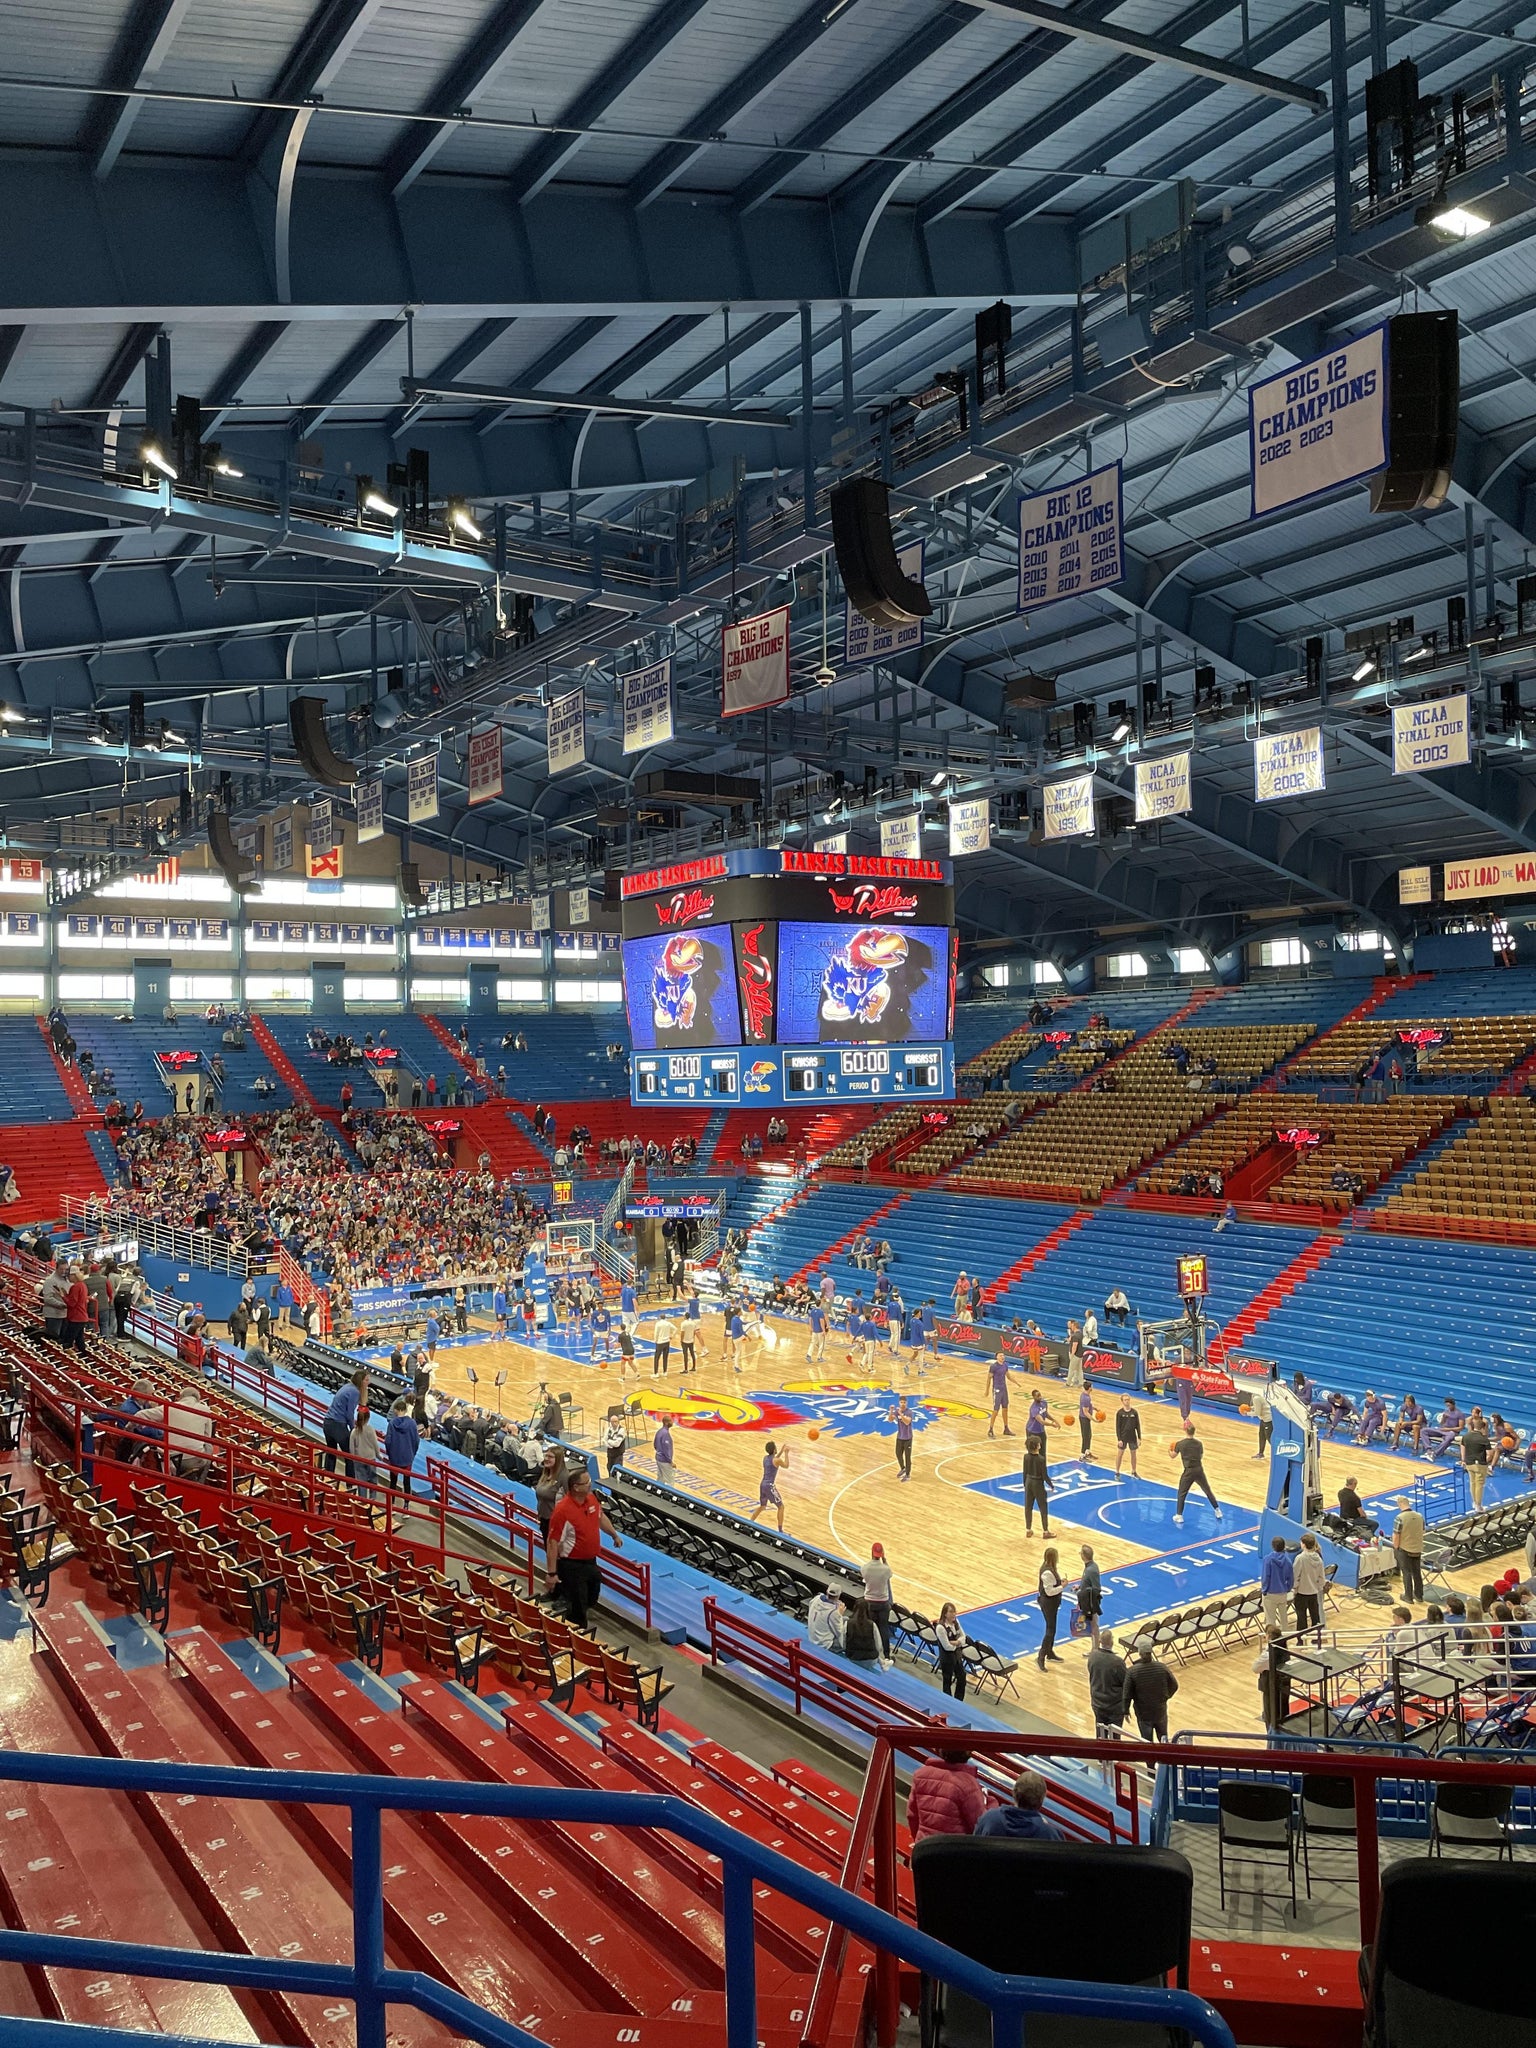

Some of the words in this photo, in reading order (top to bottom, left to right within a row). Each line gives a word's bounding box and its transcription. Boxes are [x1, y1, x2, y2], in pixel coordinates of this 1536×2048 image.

[1285, 370, 1320, 405] BIG
[1327, 354, 1347, 386] 12
[1259, 370, 1377, 443] CHAMPIONS
[1259, 440, 1293, 466] 2022
[1299, 420, 1334, 452] 2023
[1045, 492, 1073, 520] BIG
[1075, 485, 1093, 510] 12
[1024, 502, 1115, 550] CHAMPIONS
[1023, 550, 1049, 569] 2010
[1059, 540, 1081, 560] 2011
[1090, 527, 1116, 548] 2012
[1023, 566, 1048, 586] 2013
[1058, 556, 1081, 577] 2014
[1091, 544, 1117, 566] 2015
[1022, 583, 1047, 603] 2016
[1057, 574, 1082, 594] 2017
[1090, 560, 1119, 583] 2020
[739, 627, 757, 646] BIG
[759, 621, 771, 640] 12
[727, 635, 784, 668] CHAMPIONS
[628, 675, 641, 694] BIG
[642, 666, 666, 690] EIGHT
[626, 682, 668, 711] CHAMPIONS
[551, 705, 562, 721] BIG
[562, 695, 581, 716] EIGHT
[1412, 705, 1448, 726] NCAA
[549, 711, 583, 737] CHAMPIONS
[1397, 727, 1432, 745] FINAL
[1434, 720, 1464, 739] FOUR
[1272, 736, 1304, 755] NCAA
[470, 746, 500, 768] CHAMPIONS
[1260, 755, 1289, 774] FINAL
[1290, 749, 1319, 767] FOUR
[1412, 744, 1449, 765] 2003
[1149, 763, 1176, 780] NCAA
[1139, 779, 1164, 796] FINAL
[1165, 774, 1188, 790] FOUR
[1273, 772, 1306, 792] 2002
[1055, 787, 1079, 801] NCAA
[1046, 803, 1069, 816] FINAL
[1152, 795, 1176, 812] 1993
[960, 808, 980, 821] NCAA
[889, 822, 909, 835] NCAA
[883, 836, 900, 848] FINAL
[901, 833, 918, 845] FOUR
[780, 851, 846, 875] KANSAS
[846, 856, 943, 881] BASKETBALL
[623, 870, 660, 896] KANSAS
[660, 854, 730, 887] BASKETBALL
[1447, 869, 1471, 891] JUST
[1474, 866, 1500, 887] LOAD
[1501, 869, 1515, 879] THE
[1515, 862, 1536, 883] WA
[670, 889, 715, 924] Dillons
[853, 884, 918, 915] Dillons
[16, 919, 29, 931] 13
[77, 921, 89, 932] 15
[110, 922, 125, 933] 40
[144, 923, 156, 934] 15
[177, 924, 188, 935] 14
[207, 925, 221, 936] 25
[261, 927, 270, 937] 11
[290, 928, 303, 938] 45
[319, 929, 332, 939] 34
[351, 930, 357, 939] 0
[378, 931, 385, 940] 4
[423, 932, 434, 941] 10
[499, 934, 511, 944] 25
[524, 935, 535, 945] 45
[582, 937, 593, 946] 22
[148, 983, 158, 994] 11
[323, 984, 335, 995] 12
[479, 985, 489, 996] 13
[665, 985, 680, 1002] KU
[846, 977, 868, 996] KU
[742, 955, 773, 1039] Dillons
[670, 1056, 700, 1078] 60:00
[791, 1056, 819, 1068] KANSAS
[842, 1051, 888, 1073] 60:00
[646, 1073, 654, 1093] 0
[727, 1071, 736, 1093] 0
[661, 1077, 667, 1088] 4
[704, 1077, 711, 1088] 4
[803, 1069, 815, 1091] 0
[927, 1065, 938, 1086] 0
[827, 1073, 836, 1085] 4
[895, 1071, 903, 1083] 4
[848, 1081, 869, 1090] PERIOD
[871, 1077, 880, 1094] 0
[688, 1082, 695, 1098] 0
[556, 1190, 570, 1202] 30
[649, 1208, 654, 1216] 0
[692, 1208, 698, 1216] 0
[1184, 1271, 1202, 1292] 30
[358, 1302, 374, 1311] CBS
[950, 1323, 982, 1341] Dillons
[1083, 1350, 1123, 1370] Dillons
[1415, 1477, 1425, 1487] KU
[590, 1832, 607, 1842] 13
[771, 1840, 785, 1848] 11
[206, 1839, 228, 1851] 15
[496, 1847, 514, 1857] 13
[538, 1887, 557, 1900] 12
[756, 1890, 772, 1899] 11
[427, 1913, 448, 1926] 13
[586, 1934, 605, 1946] 11
[807, 1927, 825, 1938] 10
[85, 1981, 113, 1998] 13
[1223, 1979, 1234, 1989] 5
[519, 2015, 542, 2029] 11
[790, 2010, 804, 2022] 9
[617, 2029, 641, 2043] 10
